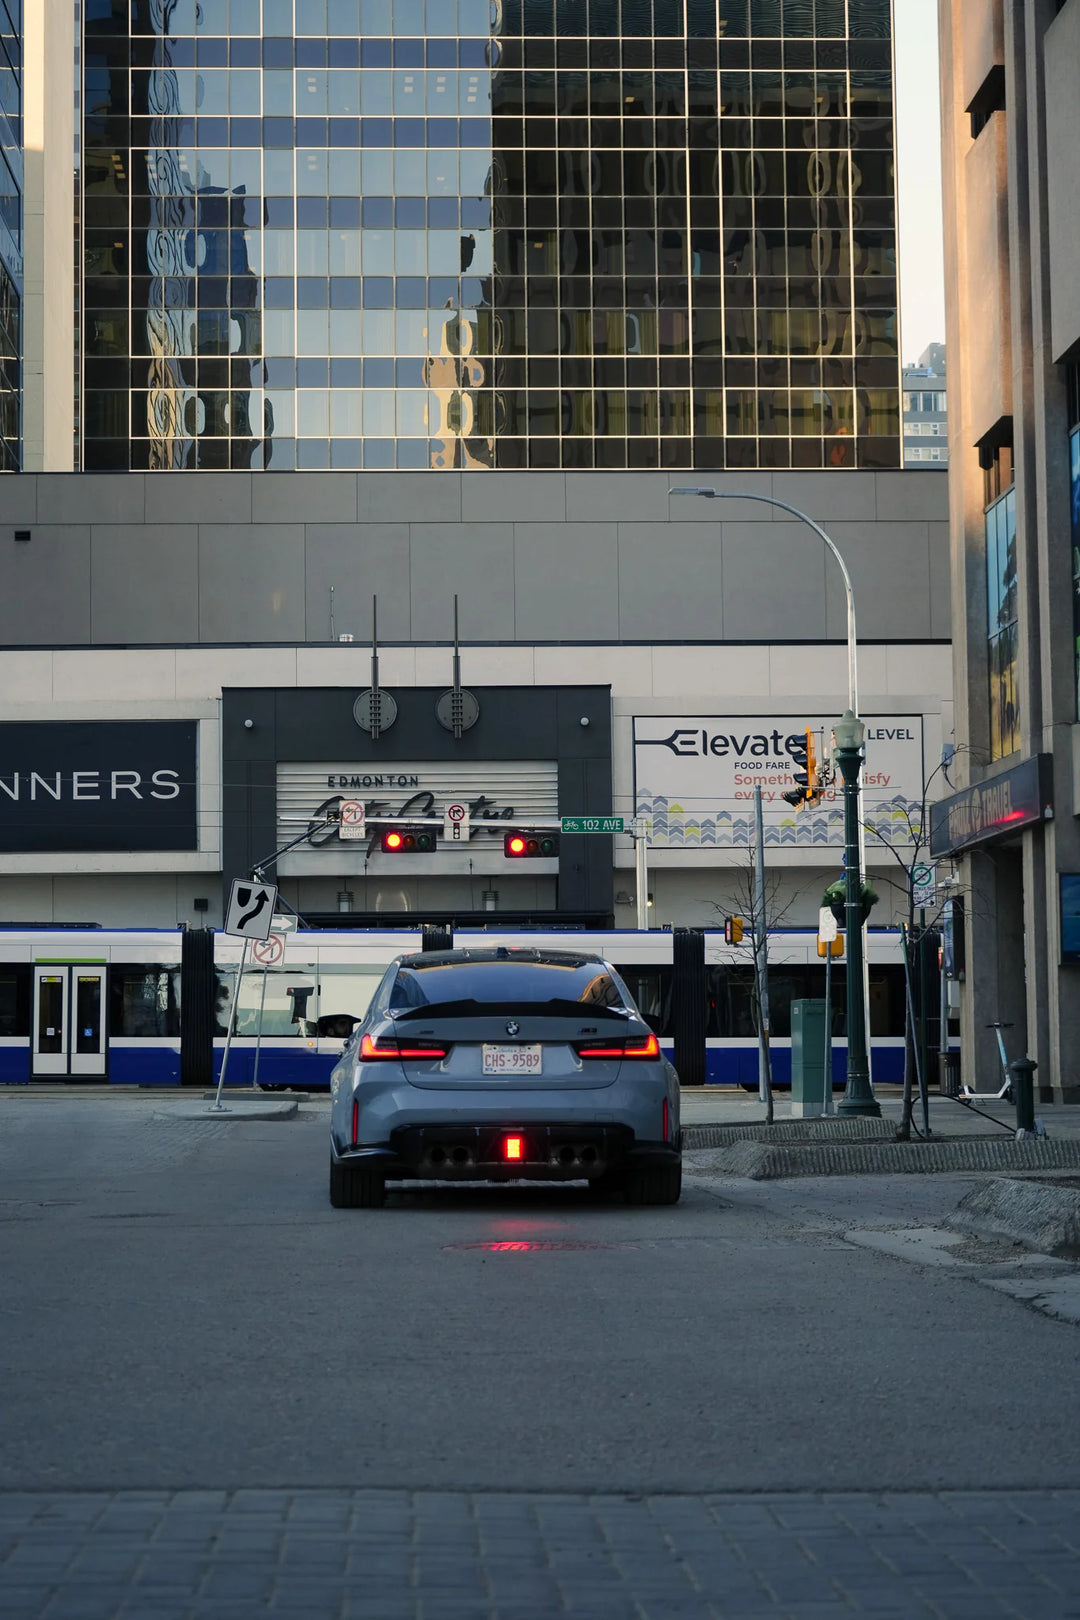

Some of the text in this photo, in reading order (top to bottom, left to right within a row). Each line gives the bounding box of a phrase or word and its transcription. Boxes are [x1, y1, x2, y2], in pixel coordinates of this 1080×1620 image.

[868, 729, 914, 741] LEVEL
[664, 729, 806, 757] Elevate
[734, 762, 791, 770] FOOD FARE
[0, 769, 181, 801] NNERS
[328, 775, 419, 788] EDMONTON
[734, 773, 797, 786] Someth
[734, 791, 775, 803] evry
[582, 819, 621, 830] 102 AVE
[485, 1053, 540, 1067] CHS-9589
